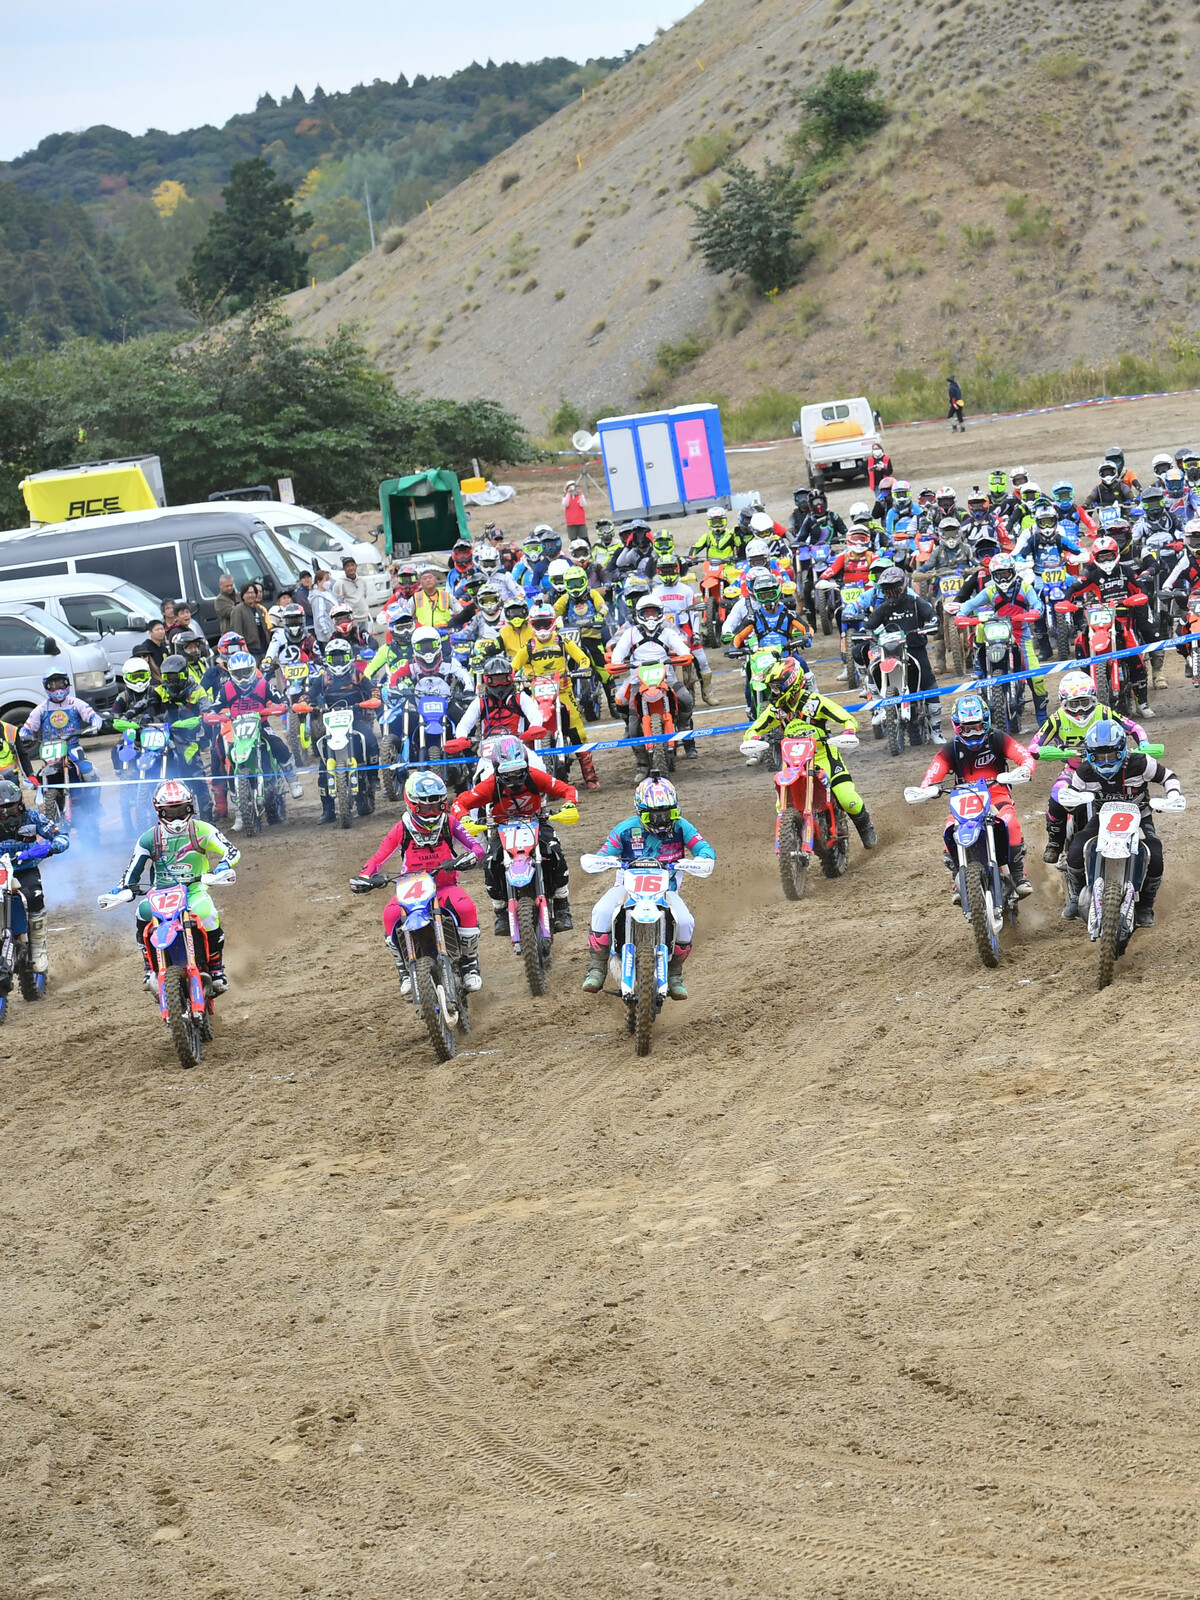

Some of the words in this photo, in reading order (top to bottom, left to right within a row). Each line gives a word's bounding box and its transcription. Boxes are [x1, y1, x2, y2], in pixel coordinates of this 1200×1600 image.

[69, 496, 120, 516] ACE
[943, 580, 961, 591] 321
[1045, 571, 1063, 583] 372
[287, 667, 306, 678] 307
[235, 722, 257, 739] 117
[143, 731, 166, 748] 119
[42, 743, 63, 760] 01
[790, 743, 806, 757] 9
[959, 795, 984, 816] 19
[1106, 812, 1134, 831] 8
[403, 881, 428, 900] 4
[634, 875, 663, 892] 16
[158, 894, 181, 910] 12
